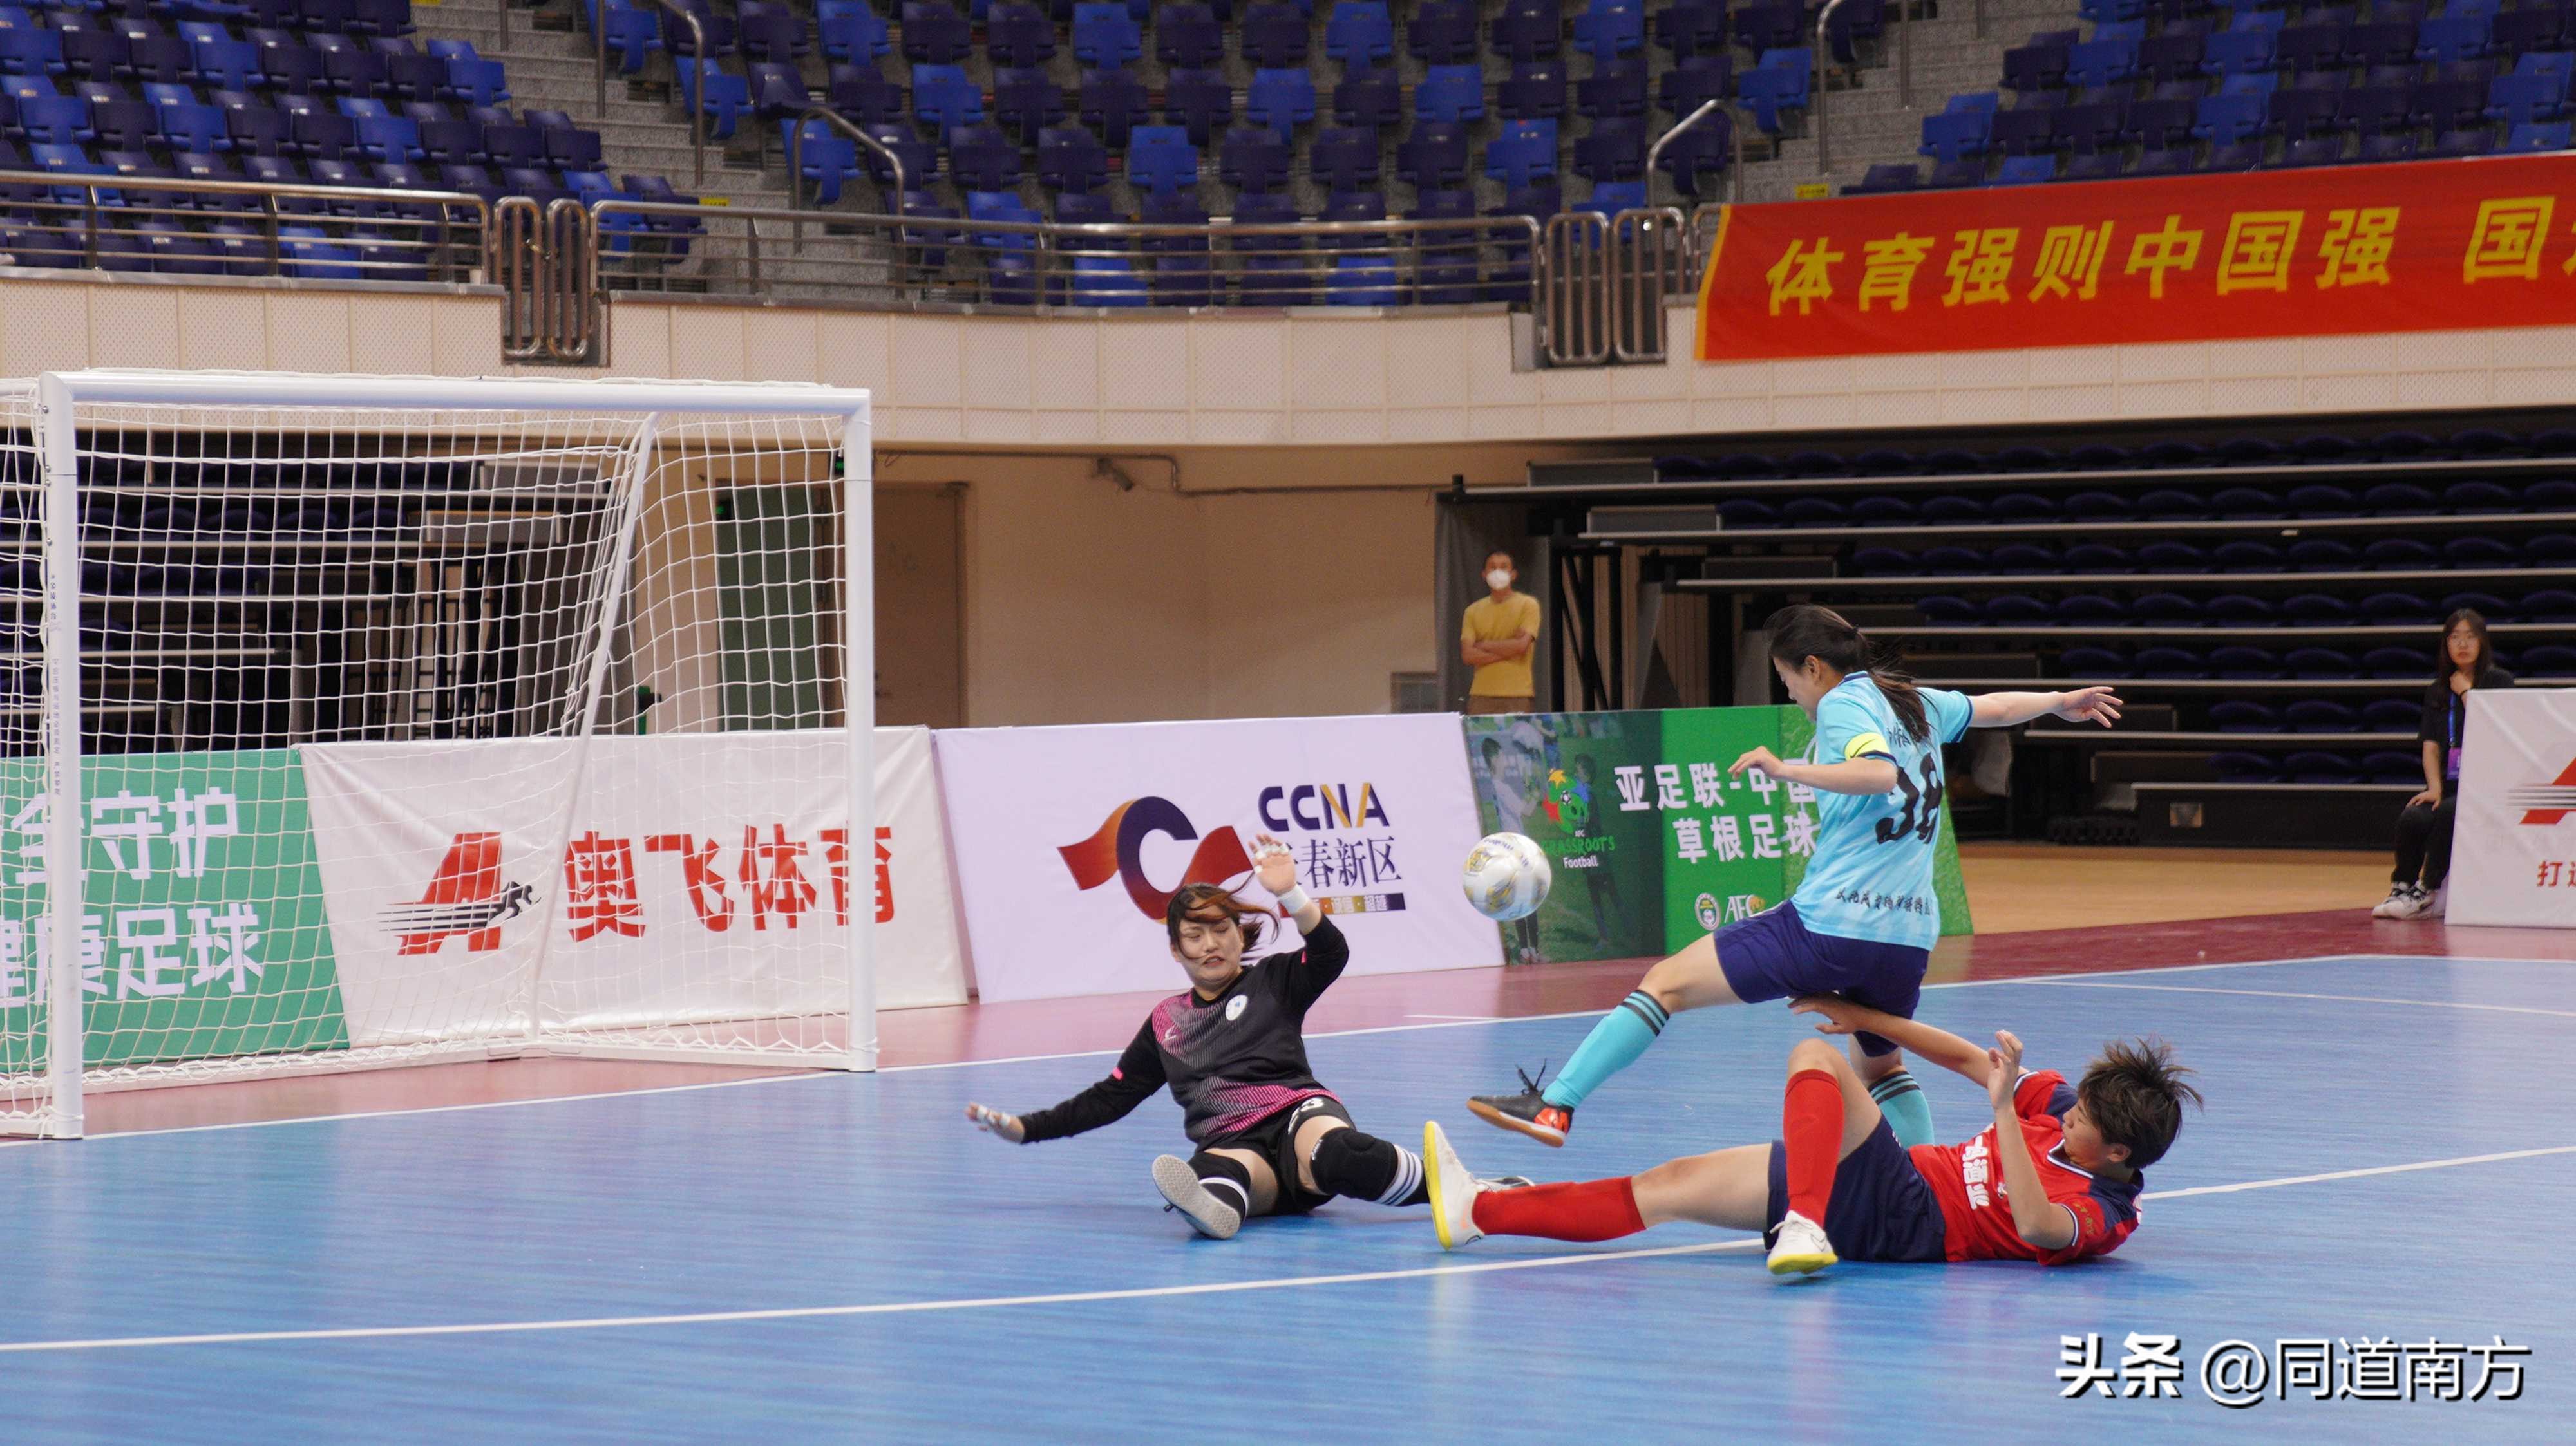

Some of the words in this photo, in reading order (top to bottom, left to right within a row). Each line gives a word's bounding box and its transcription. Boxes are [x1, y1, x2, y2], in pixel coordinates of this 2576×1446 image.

[1766, 207, 2400, 315] 体育强则中国强
[2463, 196, 2576, 283] 国
[0, 787, 239, 880] 全守护
[1258, 782, 1390, 832] CCNA
[1286, 836, 1403, 889] 春新区
[1563, 854, 1599, 869] Football
[1672, 811, 1817, 864] 草根足球
[564, 823, 895, 942] 奥飞体育
[1724, 894, 1762, 923] AFC
